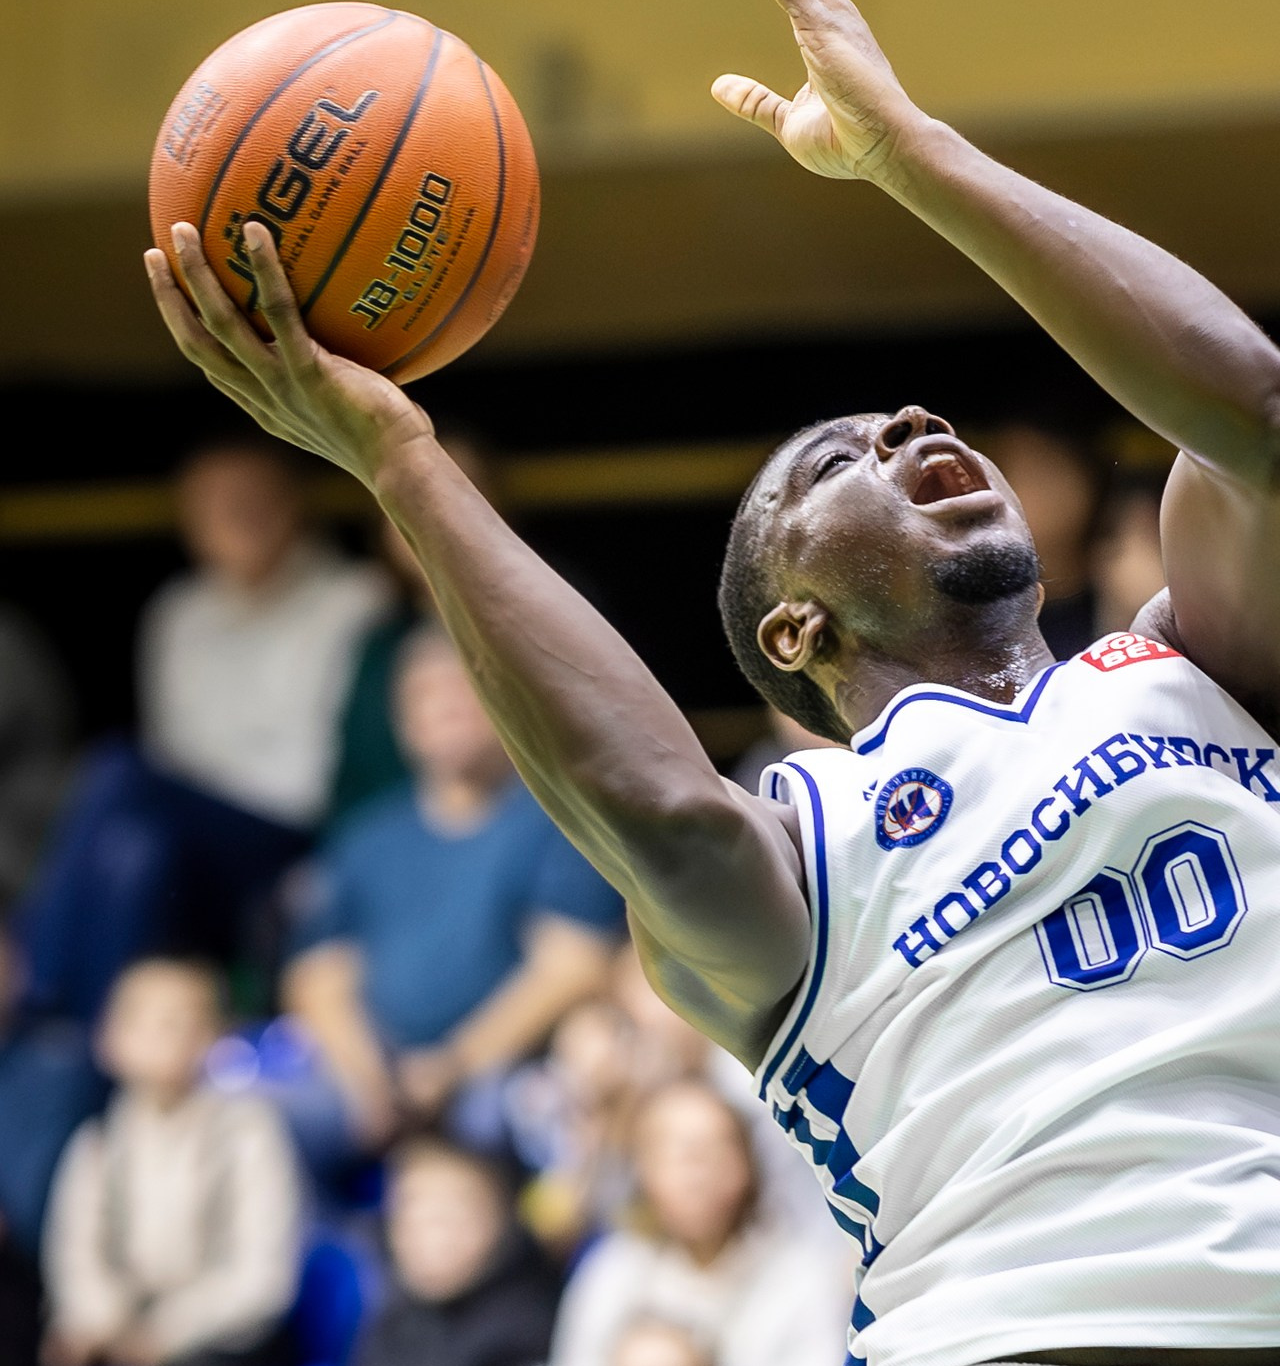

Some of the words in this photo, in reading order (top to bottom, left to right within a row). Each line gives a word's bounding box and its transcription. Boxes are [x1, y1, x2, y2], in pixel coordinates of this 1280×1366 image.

[349, 170, 454, 332] JB-1000
[1090, 634, 1146, 661] FO
[1032, 819, 1249, 992] 00
